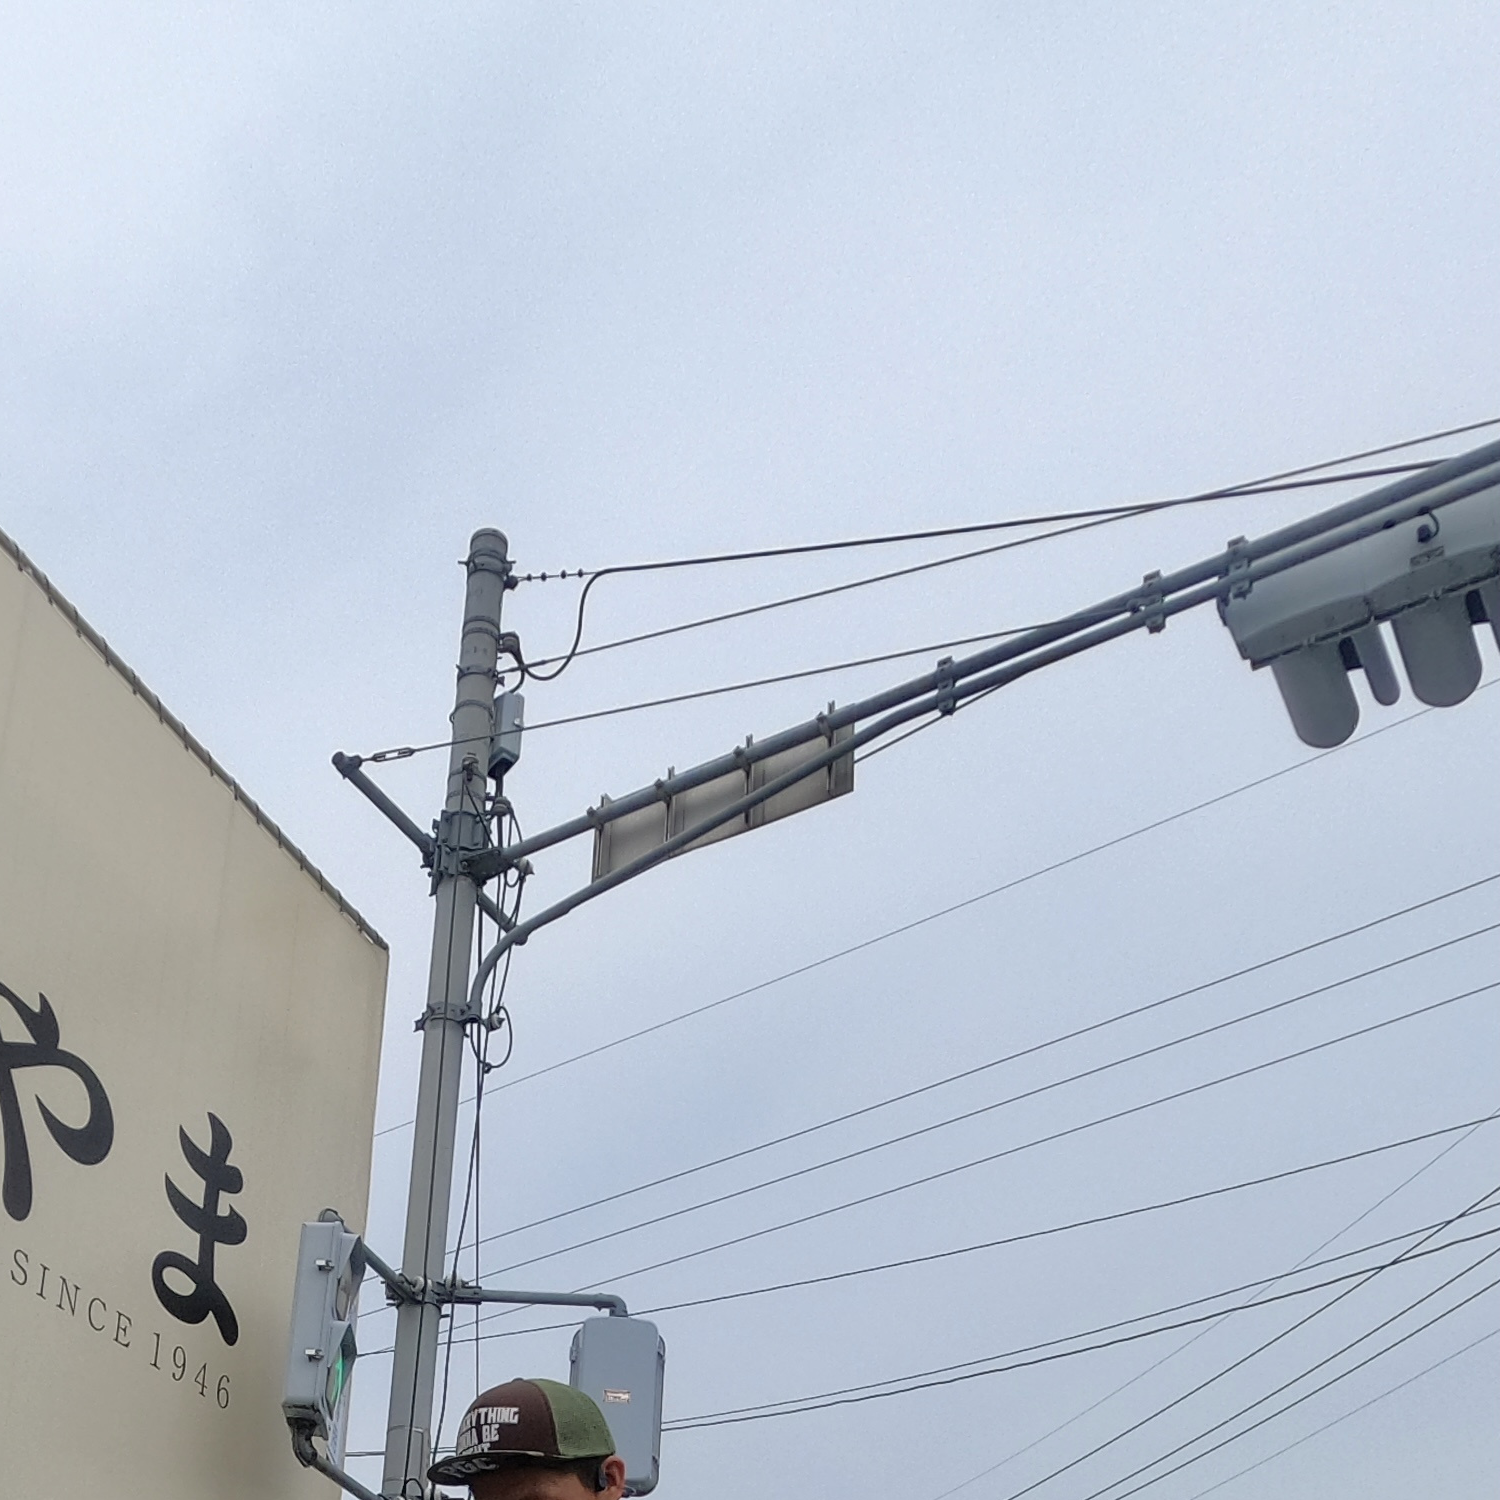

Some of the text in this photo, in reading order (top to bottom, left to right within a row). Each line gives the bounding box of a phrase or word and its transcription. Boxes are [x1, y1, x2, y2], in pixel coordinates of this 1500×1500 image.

[9, 1248, 133, 1348] SINCE
[149, 1331, 231, 1410] 1946
[481, 1423, 500, 1443] BE
